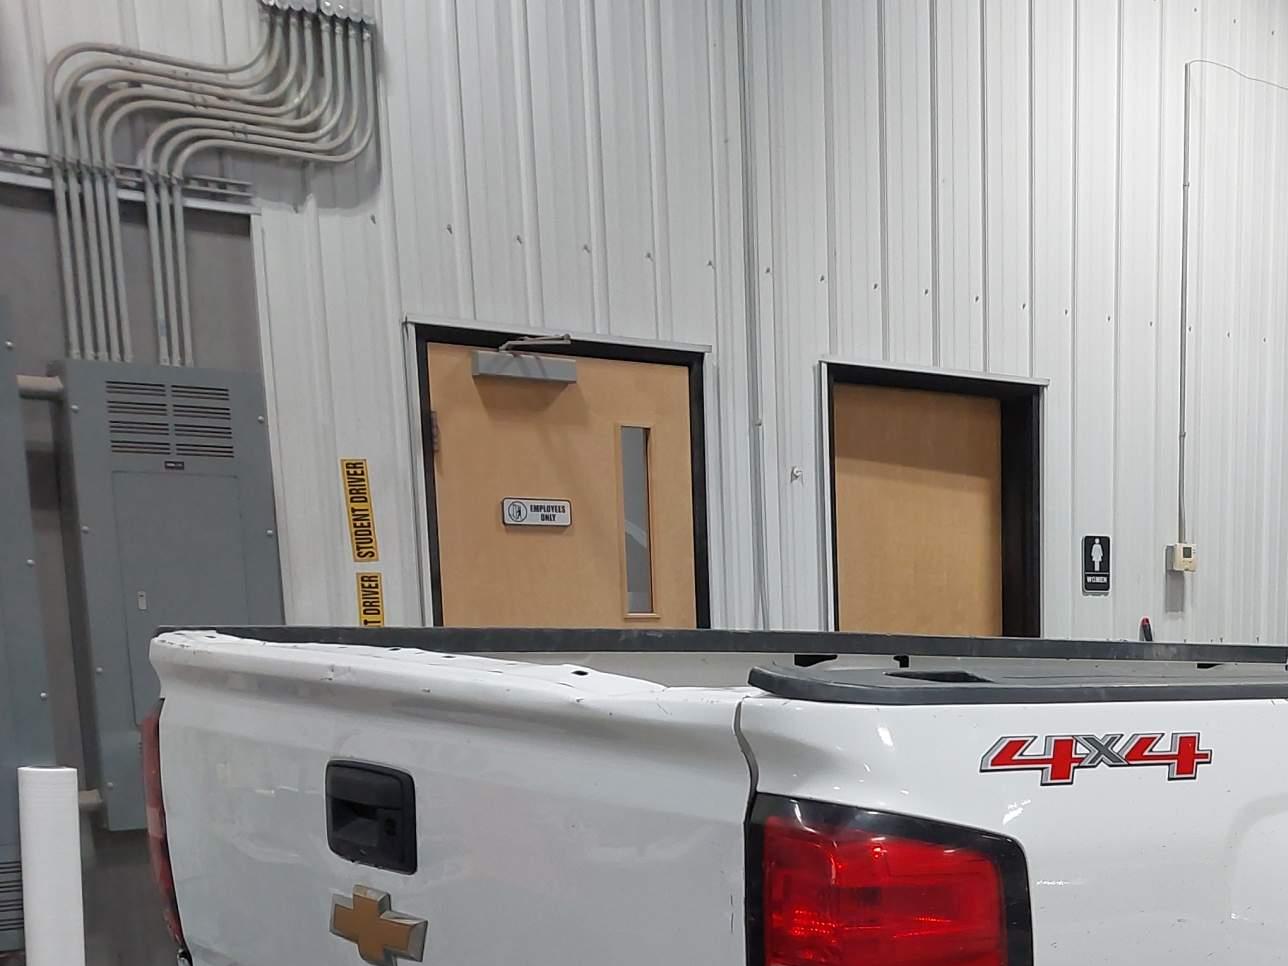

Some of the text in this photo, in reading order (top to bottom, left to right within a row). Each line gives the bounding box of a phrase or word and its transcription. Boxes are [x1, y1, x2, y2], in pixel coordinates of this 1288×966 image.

[345, 461, 376, 559] STUDENT DRIVER
[529, 504, 566, 514] EMPLOYEES
[540, 513, 557, 522] ONLY
[360, 575, 381, 616] DRIVER
